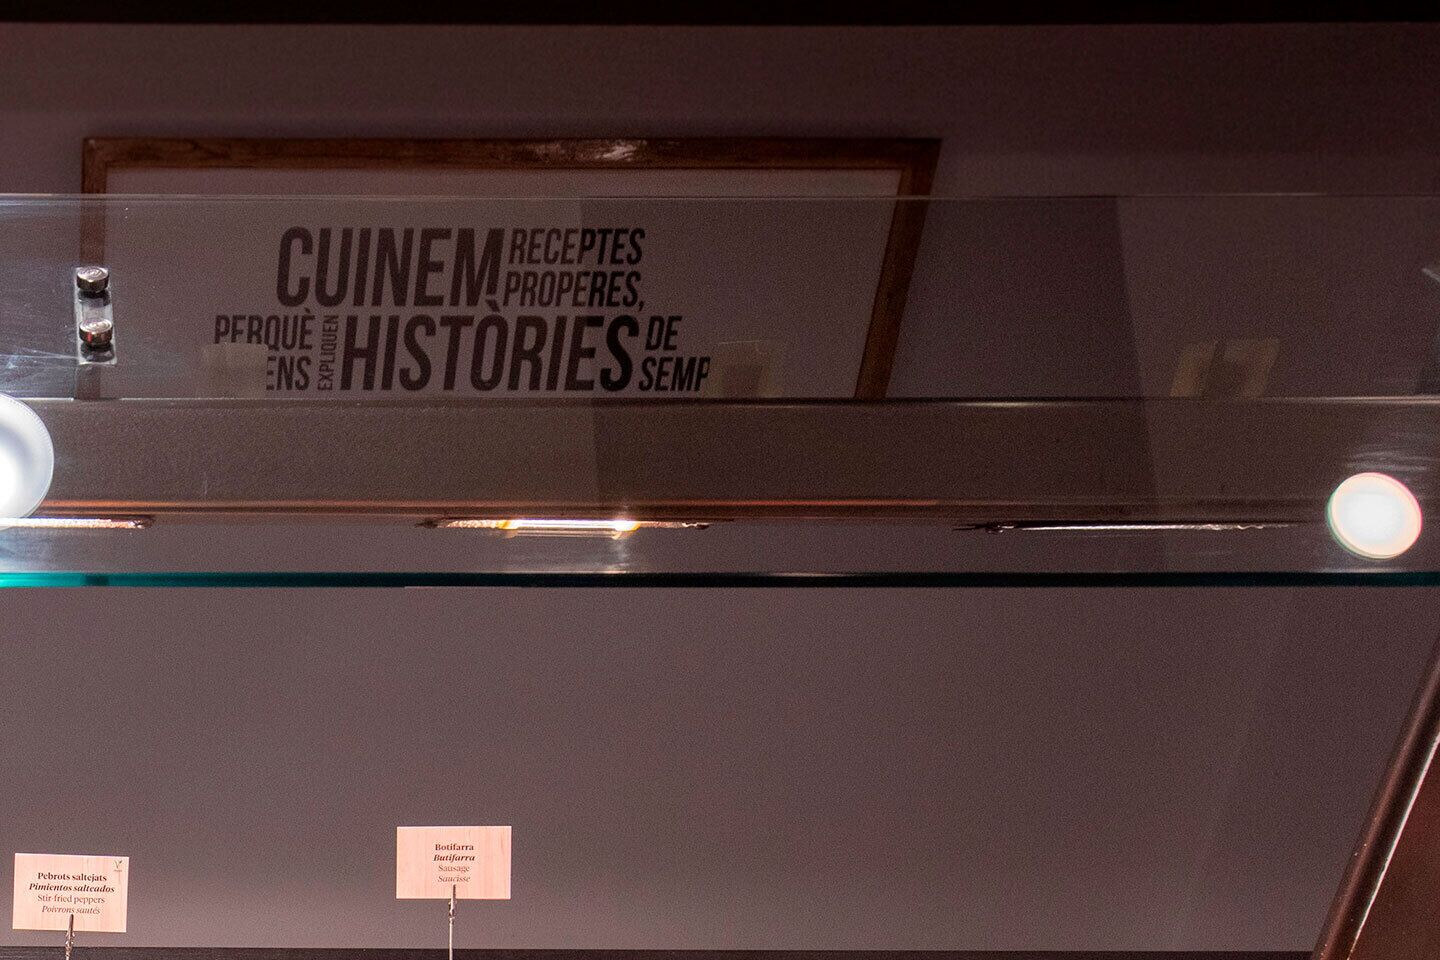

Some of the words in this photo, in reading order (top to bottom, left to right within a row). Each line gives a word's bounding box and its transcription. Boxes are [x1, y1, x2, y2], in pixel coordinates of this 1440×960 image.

[507, 227, 646, 266] RECEPTES
[275, 226, 505, 308] CUINEM
[502, 270, 646, 312] PROPERES,
[213, 307, 316, 351] PERQUÈ
[645, 315, 683, 351] DE
[317, 315, 339, 391] EXPLIQUEN
[340, 300, 641, 392] HISTÒRIES
[638, 356, 711, 392] SEMP
[433, 853, 476, 863] Butifarra
[434, 843, 474, 851] Botifarra
[37, 872, 71, 880] Pebrots
[71, 873, 108, 883] saltejats
[437, 864, 470, 873] Sausage
[437, 875, 471, 883] Saucisse
[28, 882, 72, 892] Pimientos
[73, 883, 115, 893] salteados
[37, 894, 73, 903] Stir-fried
[73, 896, 106, 905] peppers
[41, 905, 75, 914] Poivrons
